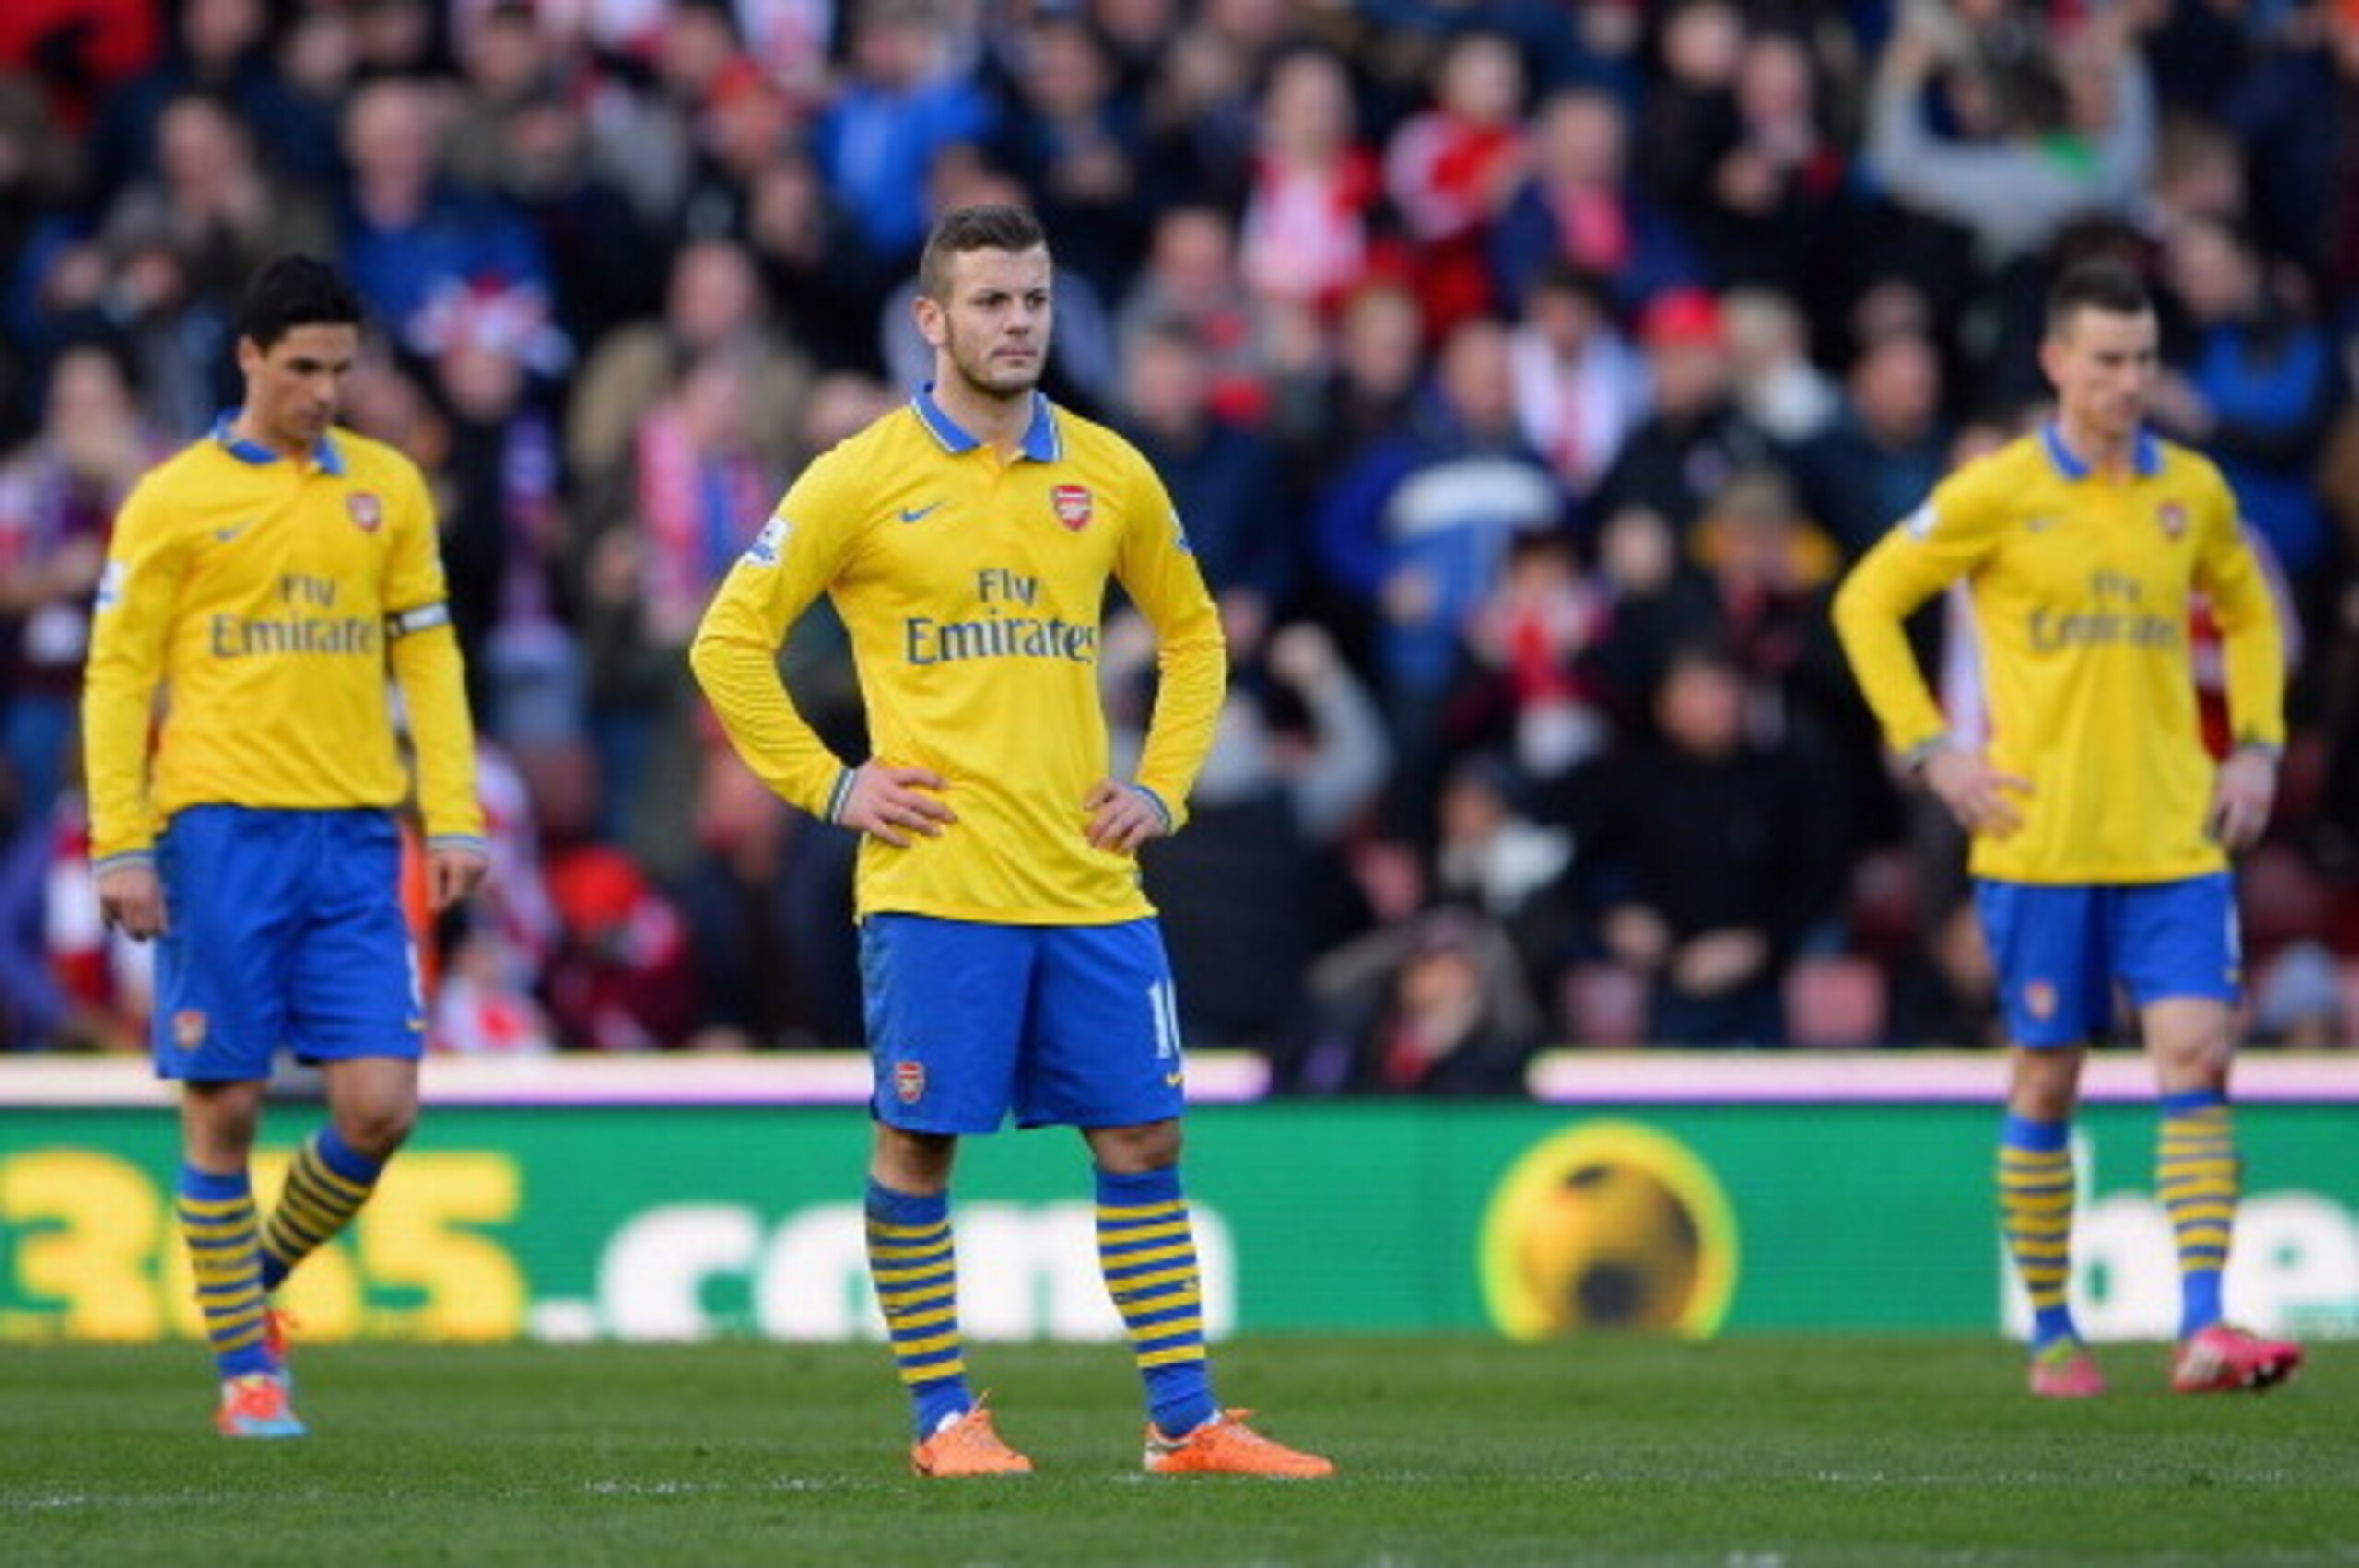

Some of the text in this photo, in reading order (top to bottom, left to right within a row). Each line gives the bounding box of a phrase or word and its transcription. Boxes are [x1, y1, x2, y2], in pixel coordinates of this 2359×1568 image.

[279, 573, 337, 608] Fly
[977, 568, 1036, 608] Fly
[211, 613, 378, 658] Emirate
